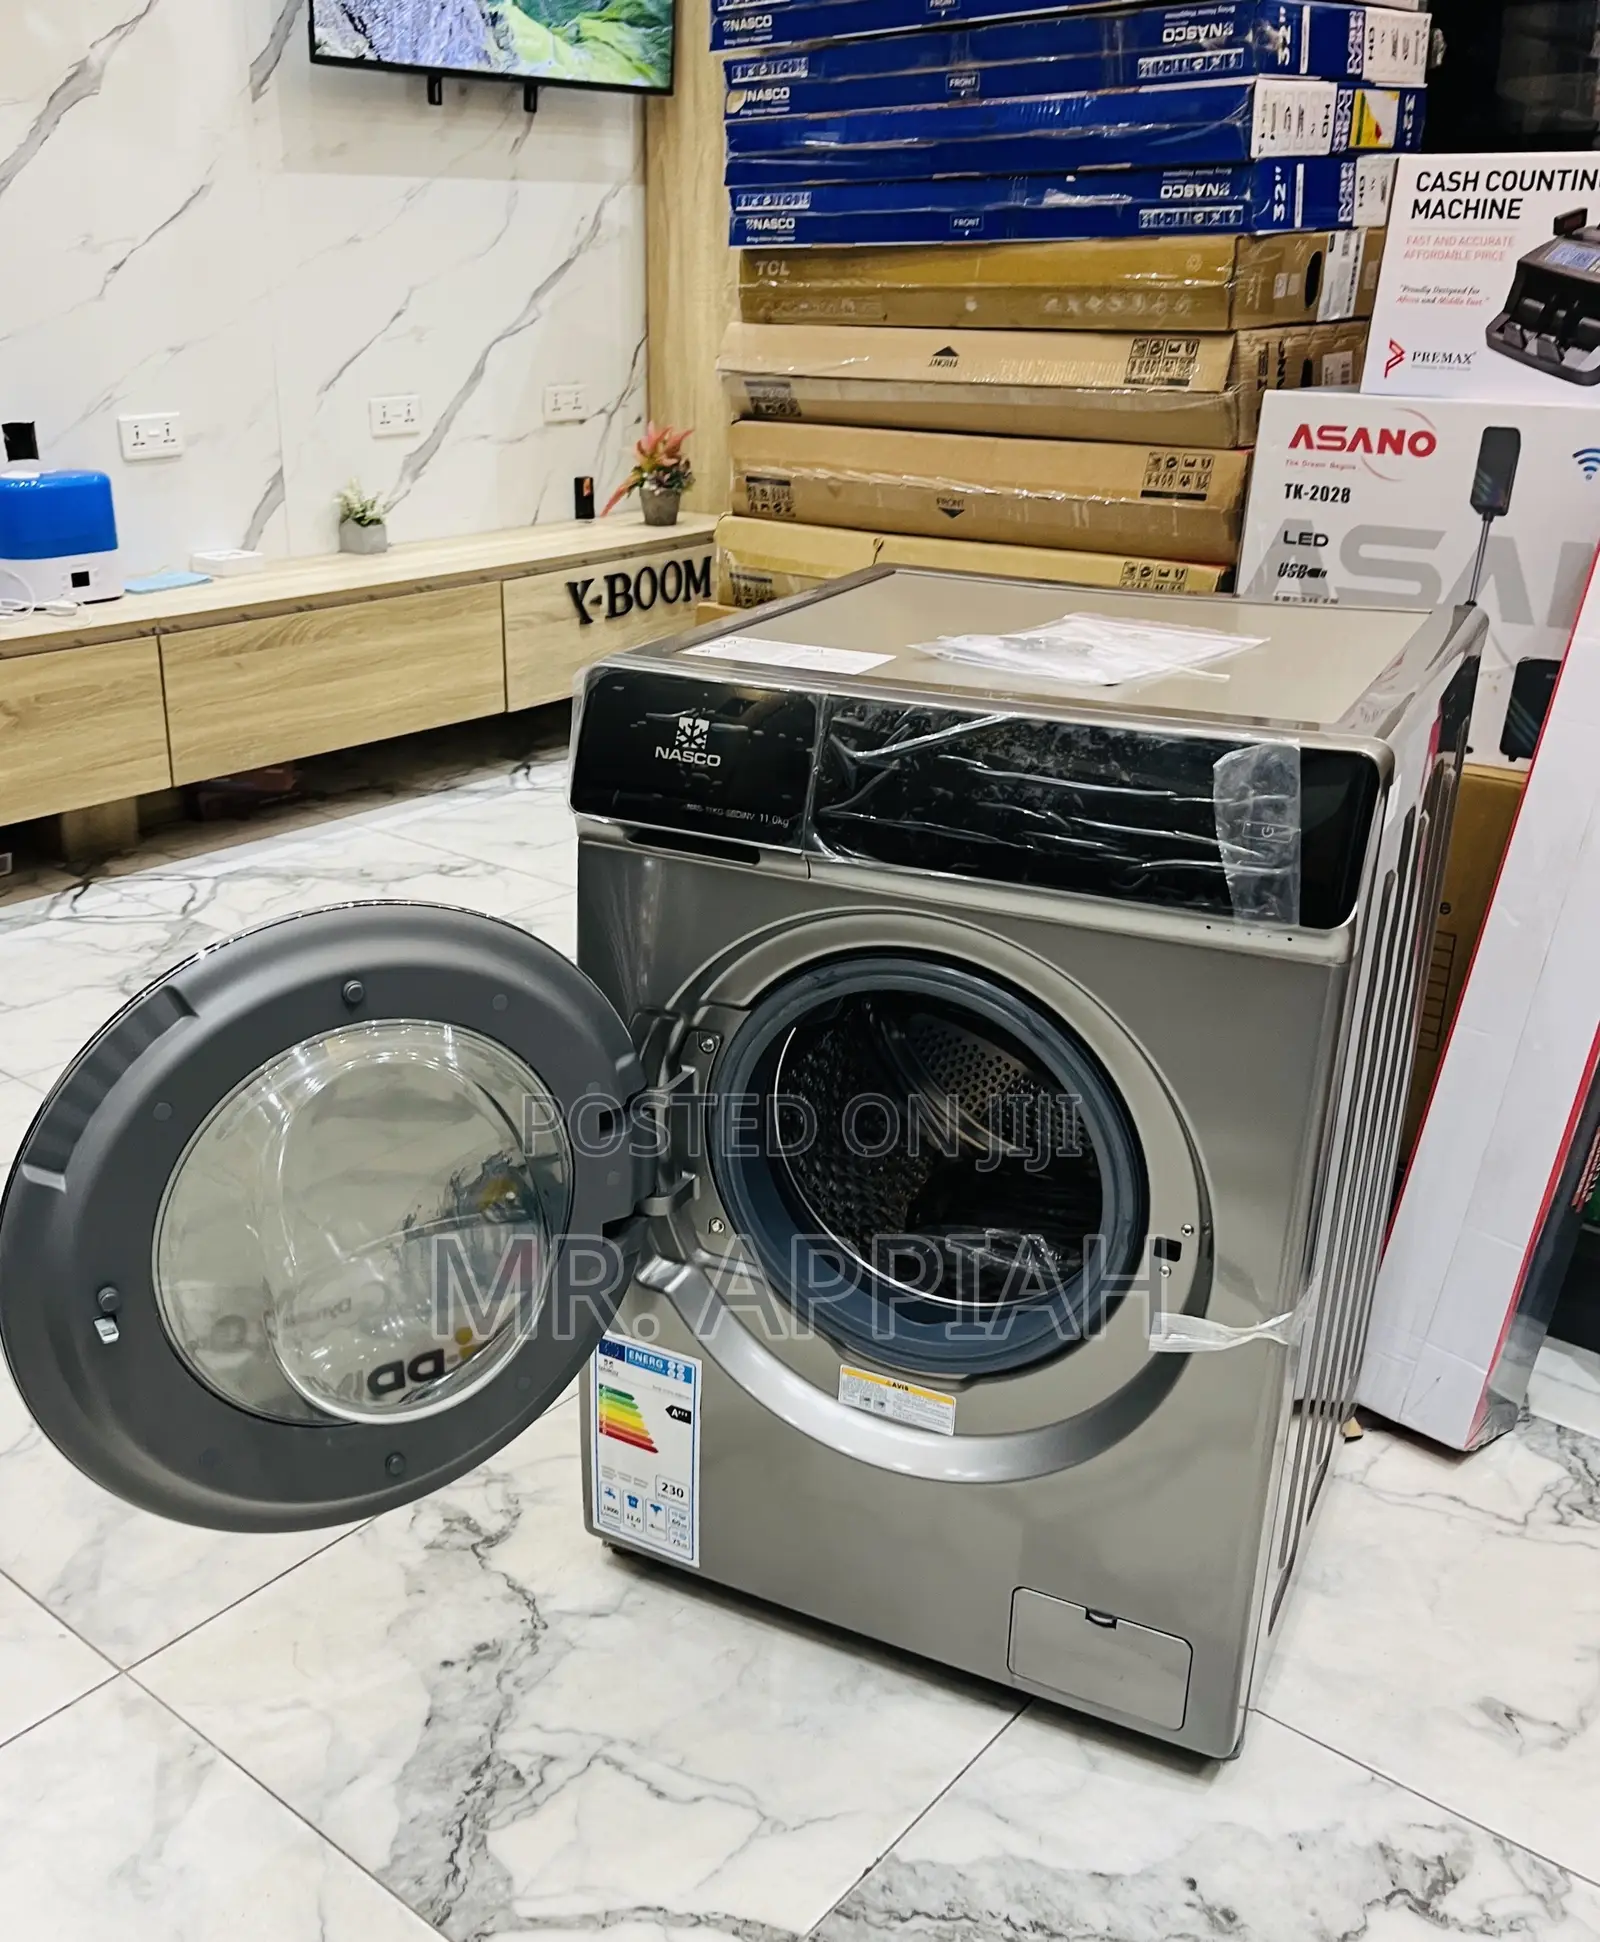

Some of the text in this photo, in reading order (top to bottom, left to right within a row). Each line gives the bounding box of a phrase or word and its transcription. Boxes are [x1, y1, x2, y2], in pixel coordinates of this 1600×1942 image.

[730, 14, 772, 31] NASCO
[1162, 22, 1223, 43] NASCO
[949, 76, 976, 88] FRONT
[747, 87, 790, 102] NASCO
[1416, 170, 1480, 192] CASH
[1485, 169, 1600, 192] COUNTIN
[1160, 182, 1220, 199] NASCO
[1411, 198, 1523, 220] MACHINE
[753, 217, 796, 231] NASCO
[953, 218, 980, 228] FRONT
[1406, 235, 1515, 247] FAST AND ACCURATE
[1404, 249, 1505, 261] AFFORDABLE PRICE
[755, 260, 790, 276] TCL
[1411, 350, 1471, 364] PREMAX
[1288, 423, 1437, 457] ASANO
[1284, 483, 1351, 504] TK-2028
[1283, 530, 1329, 547] LED
[1277, 562, 1308, 579] USB
[565, 556, 712, 625] Y-BOOM
[655, 746, 721, 767] NASCO
[760, 813, 790, 829] 11.0kg
[628, 1350, 664, 1369] ENERG
[891, 1381, 909, 1392] AVIS
[661, 1482, 684, 1499] 230
